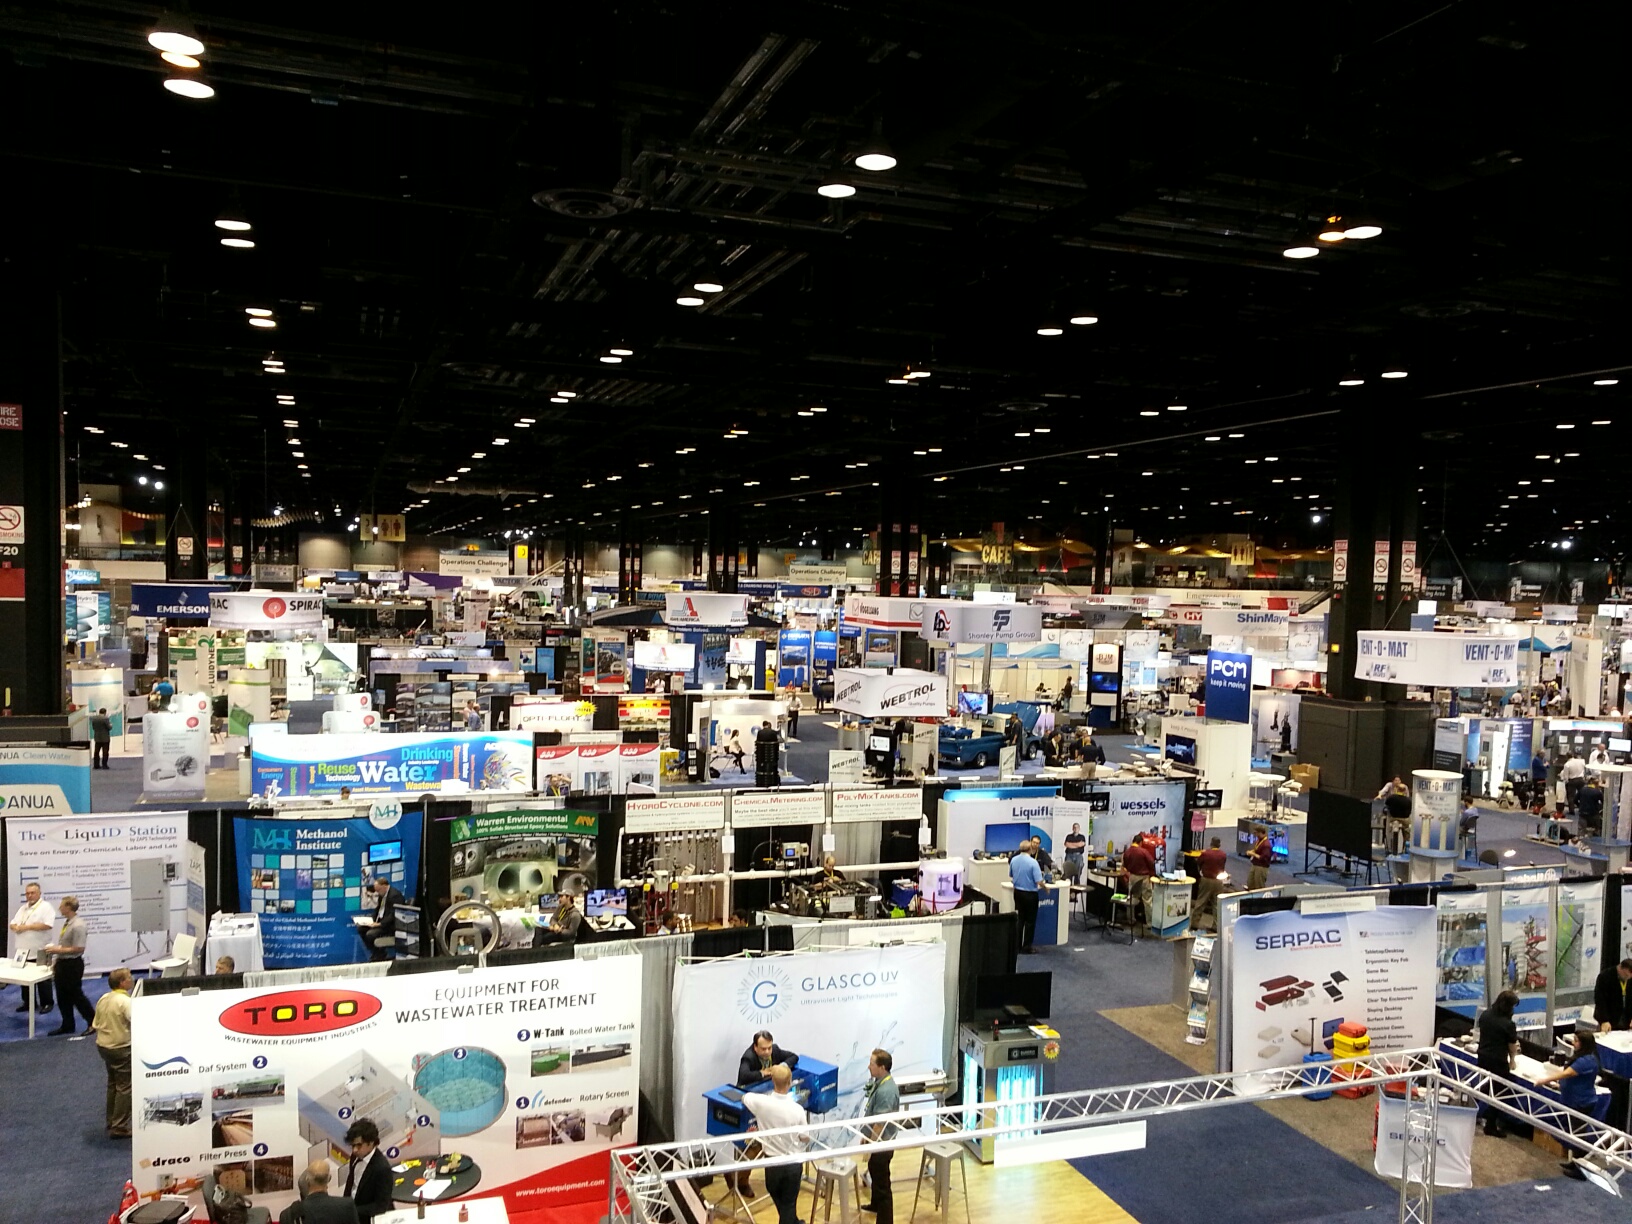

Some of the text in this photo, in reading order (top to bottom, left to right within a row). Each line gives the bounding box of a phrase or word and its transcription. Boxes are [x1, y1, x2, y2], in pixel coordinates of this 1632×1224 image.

[0, 407, 16, 416] IRE
[0, 417, 19, 427] OSE
[982, 545, 1012, 564] CAFE
[477, 559, 508, 567] Challenge
[820, 568, 846, 576] Challenge
[156, 605, 209, 614] EMERSON
[289, 599, 321, 611] SPIRAC
[968, 631, 1036, 641] Shanley Pump Group
[1211, 659, 1247, 679] PCM
[1210, 678, 1222, 688] keep
[1228, 681, 1246, 691] moving
[880, 683, 936, 710] WEBTROL
[0, 752, 19, 760] NUA
[401, 747, 453, 763] Drinking
[318, 763, 357, 775] Reuse
[831, 757, 860, 769] WEBTROL
[261, 772, 284, 780] Energy
[325, 774, 361, 783] Technology
[356, 761, 437, 784] Water
[7, 795, 55, 809] ANUA
[1120, 797, 1166, 810] wessels
[476, 815, 568, 827] Warren Environmental
[18, 826, 177, 841] The LiquID Station
[295, 827, 348, 839] Methanol
[295, 840, 342, 850] Institute
[52, 848, 81, 856] Energy,
[1255, 929, 1342, 951] SERPAC
[801, 970, 899, 992] GLASCO UV
[434, 978, 560, 1002] EQUIPMENT FOR
[752, 980, 778, 1009] G
[800, 992, 898, 1005] Ultraviolet Light Technologies
[244, 999, 358, 1025] TORO
[395, 993, 597, 1024] WASTEWATER TREATMENT
[223, 1021, 379, 1046] WASTEWATER EQUIPMENT INDUSTRIES
[533, 1026, 565, 1039] W-Tank
[569, 1027, 593, 1036] Bolted
[594, 1024, 617, 1033] Water
[617, 1022, 635, 1031] Tank
[145, 1067, 190, 1078] anaconda
[198, 1063, 214, 1074] Daf
[215, 1061, 248, 1073] System
[544, 1097, 573, 1106] defender
[579, 1091, 604, 1102] Rotary
[605, 1089, 630, 1099] Screen
[152, 1155, 191, 1167] draco
[199, 1151, 222, 1162] Filter
[223, 1149, 248, 1160] Press
[515, 1179, 606, 1197] www.toroequipment.com
